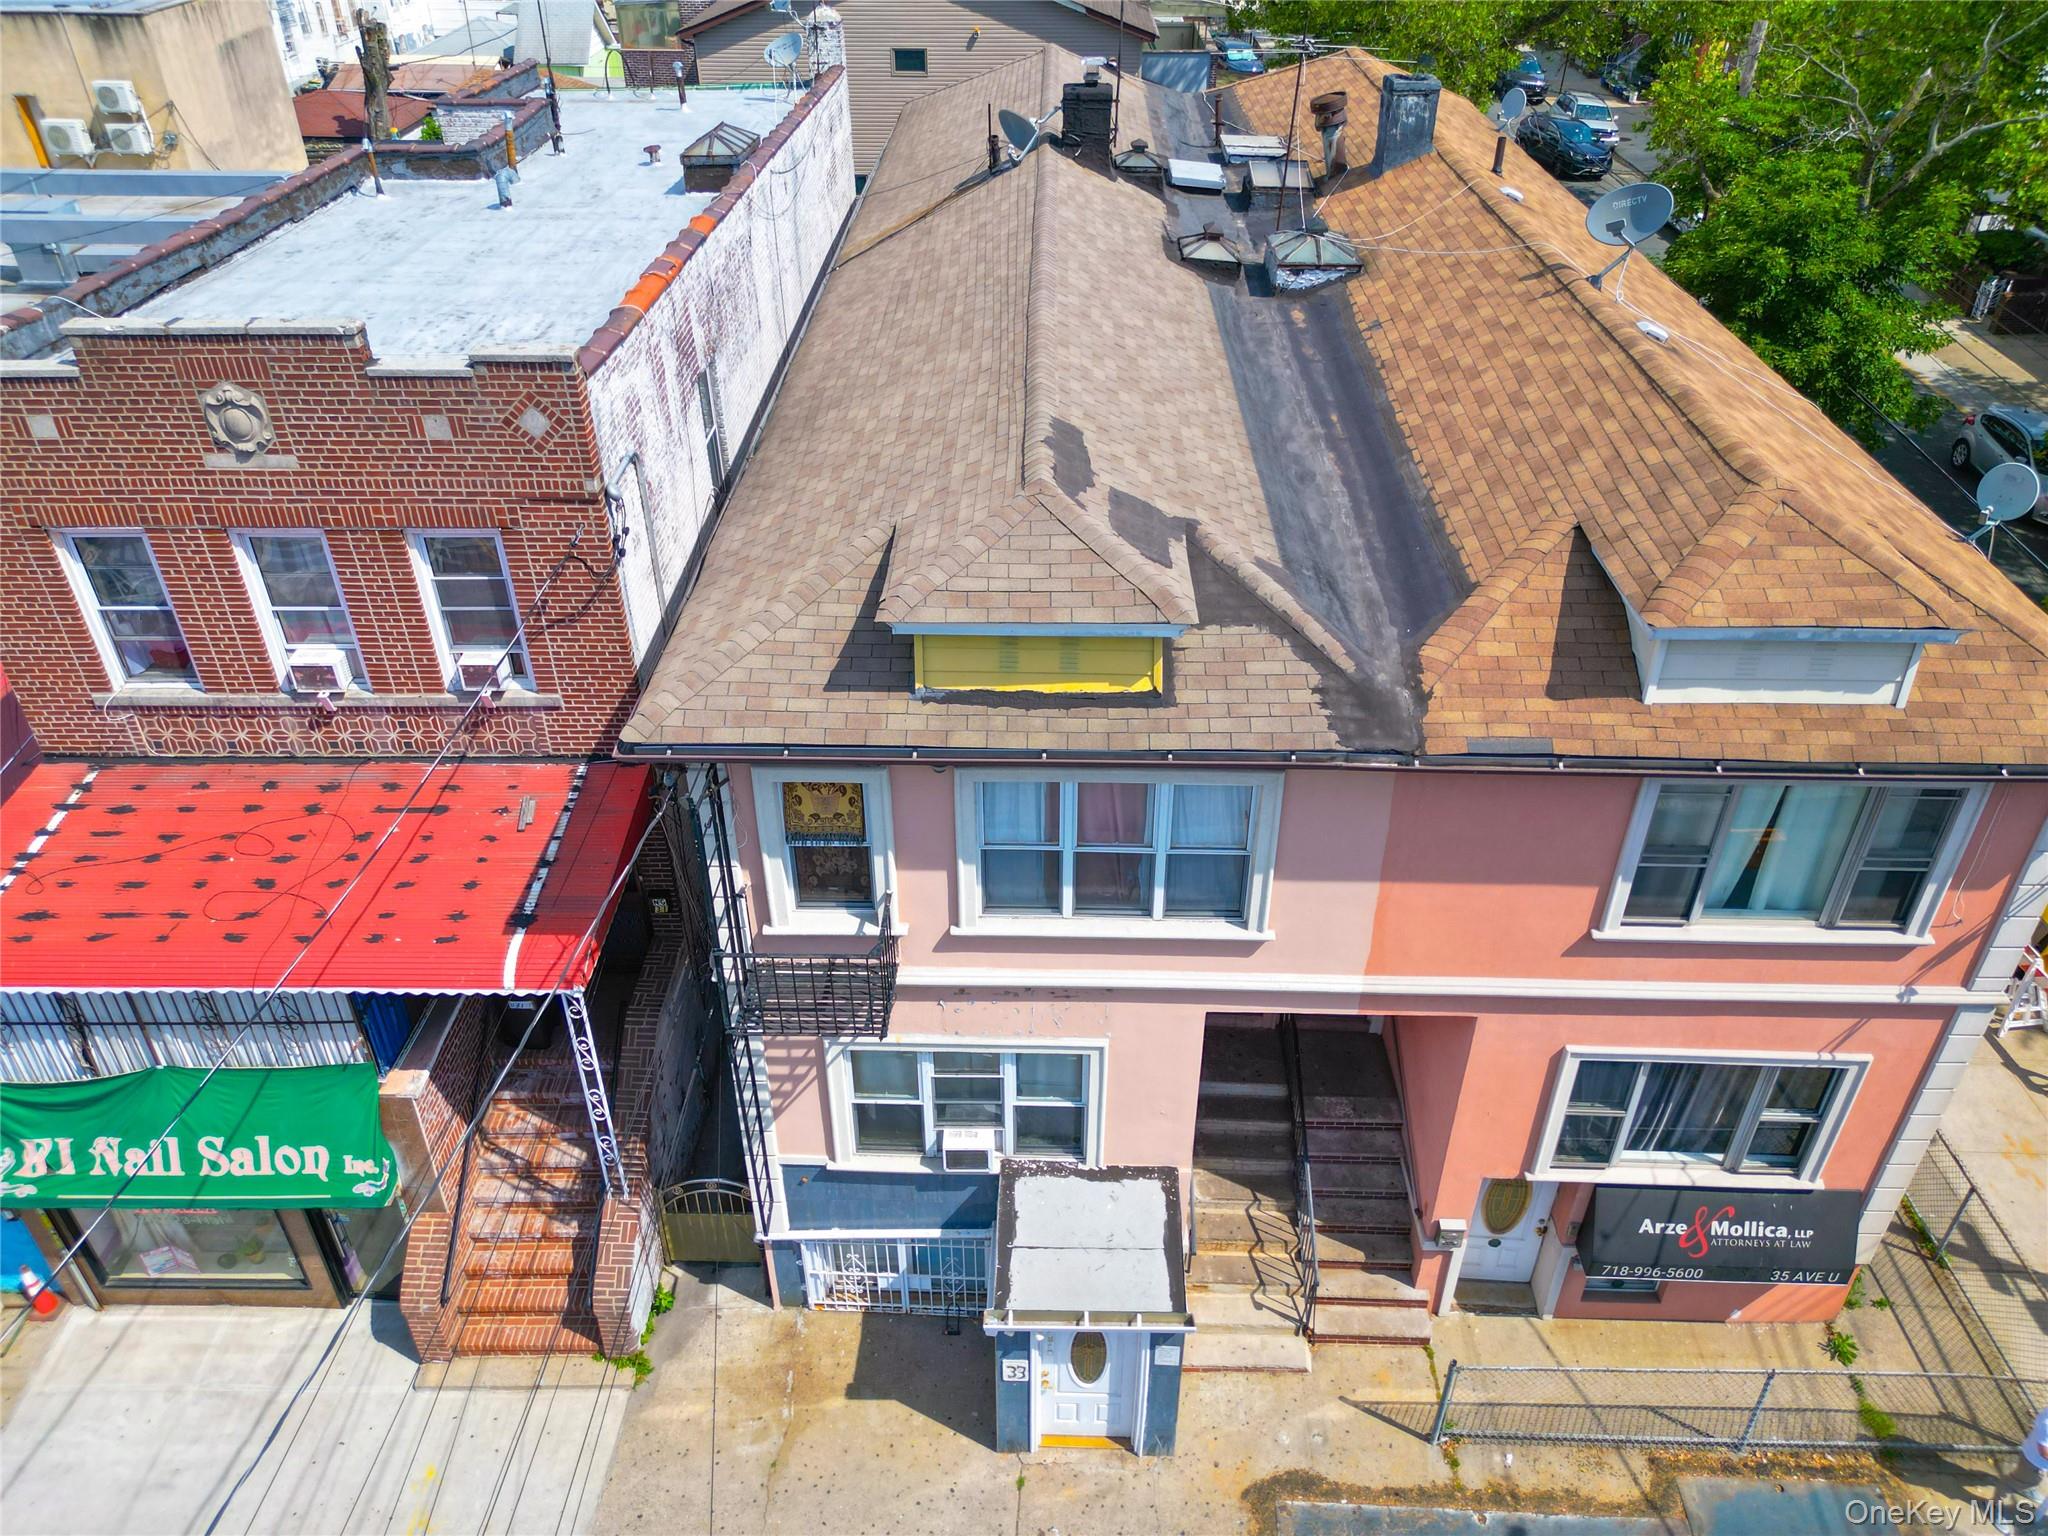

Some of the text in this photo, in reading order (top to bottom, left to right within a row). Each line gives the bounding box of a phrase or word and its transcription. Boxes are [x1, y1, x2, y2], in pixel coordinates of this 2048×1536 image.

[1612, 194, 1648, 209] DIRECTV
[88, 1136, 185, 1177] Nail
[197, 1135, 330, 1182] Salon
[343, 1154, 380, 1177] Inc.
[1638, 1218, 1687, 1235] Arze
[1794, 1229, 1814, 1238] LLP
[1710, 1238, 1812, 1249] ATTORNEYS AT LAW
[1601, 1264, 1703, 1279] 718-996-5600
[1770, 1270, 1840, 1283] 35 AVE U
[1007, 1365, 1026, 1380] 33
